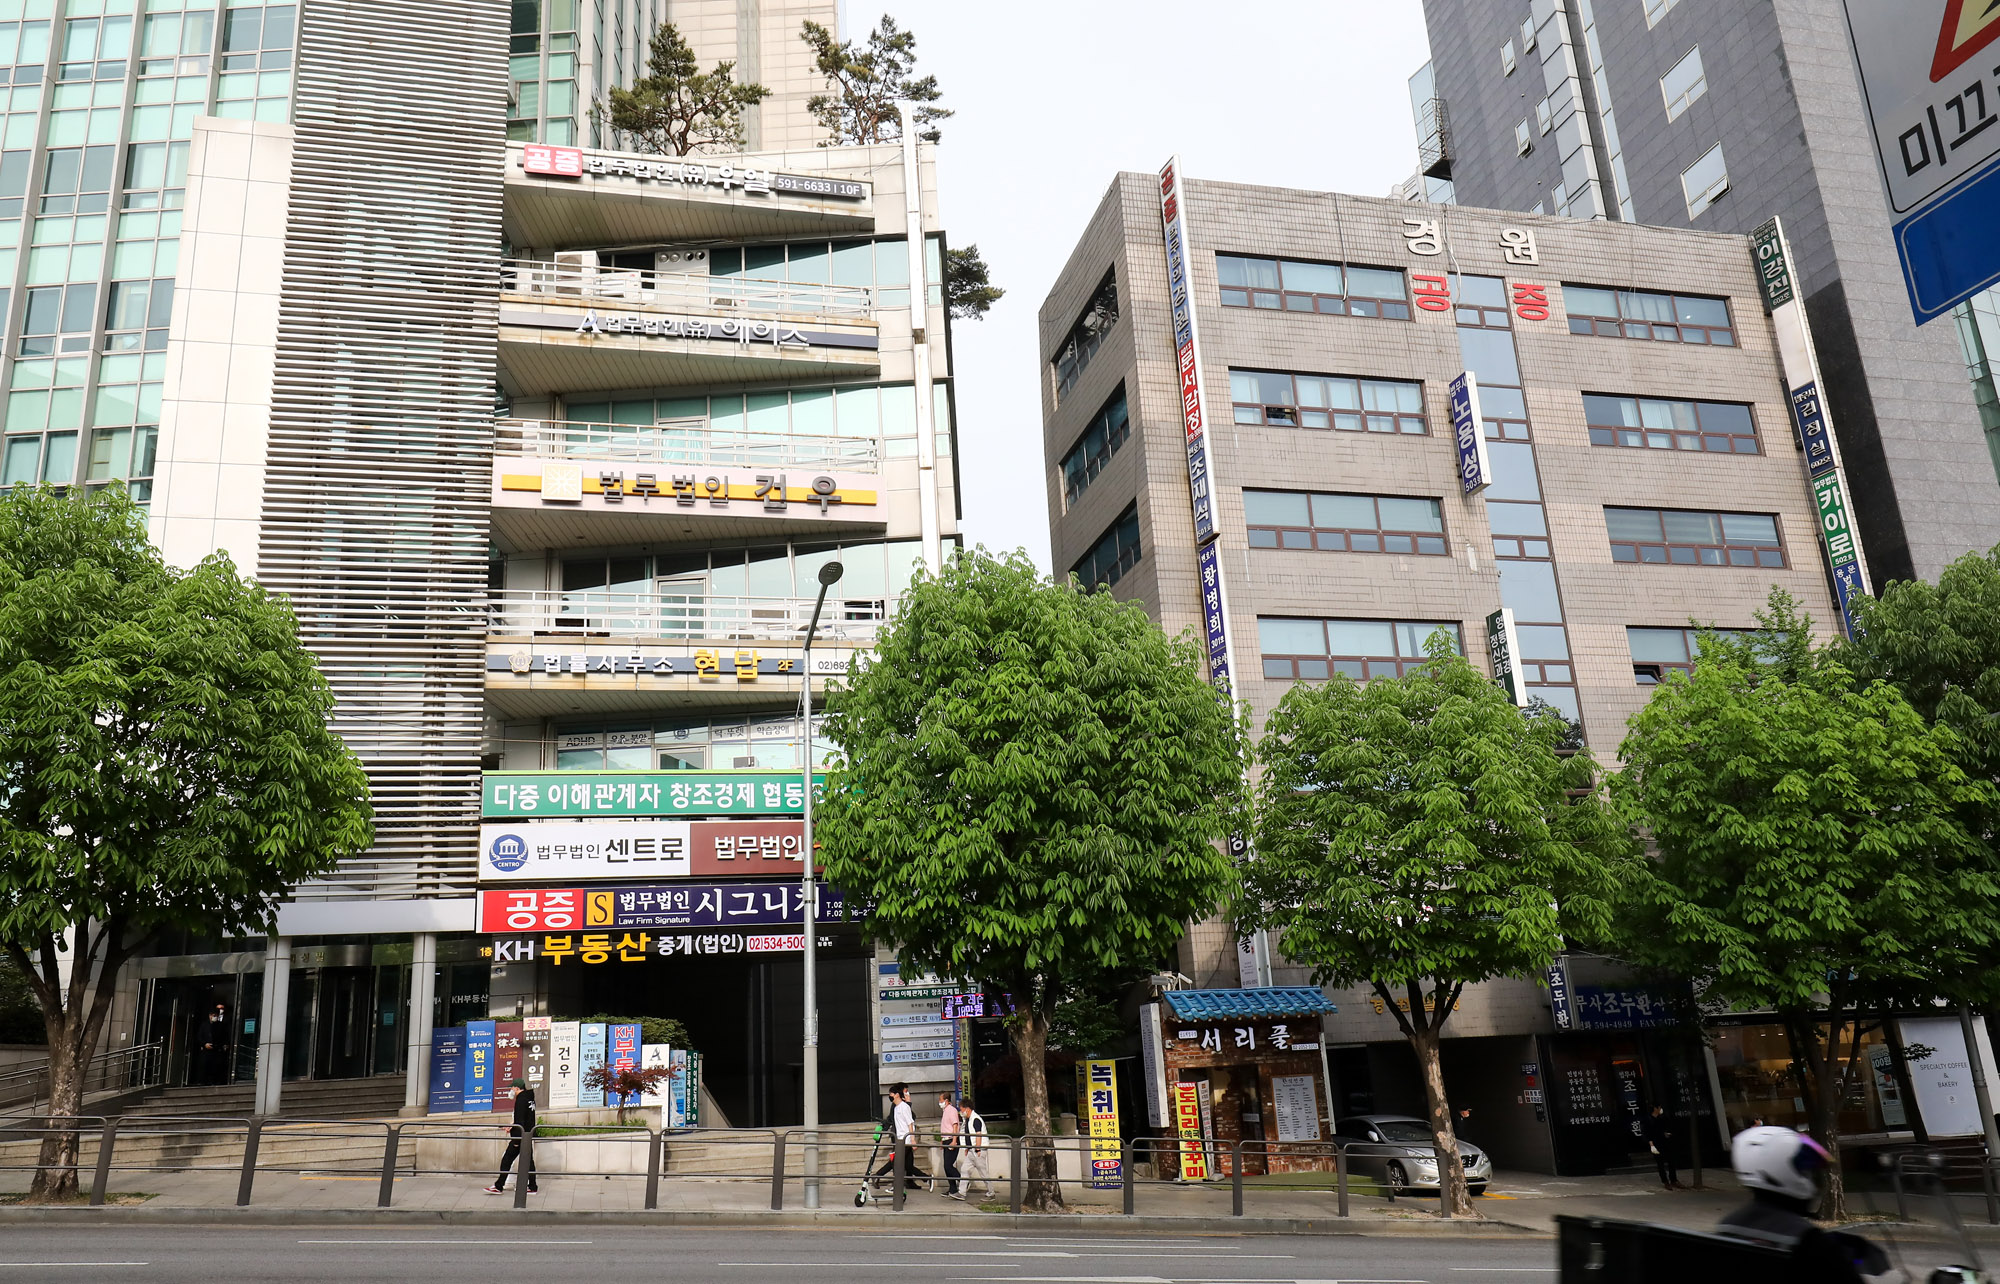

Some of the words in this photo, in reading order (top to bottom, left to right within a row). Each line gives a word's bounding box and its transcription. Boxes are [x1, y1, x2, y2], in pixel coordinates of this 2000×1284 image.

[1899, 66, 2000, 177] 미끄
[528, 148, 579, 173] 공증
[589, 158, 709, 185] 법무법인(유)
[713, 165, 770, 194] 우일
[777, 178, 831, 193] 591-6633
[840, 184, 861, 195] 10F
[1161, 165, 1177, 224] 공증
[1168, 223, 1182, 284] 법무법인
[1759, 243, 1790, 298] 이강진
[1173, 282, 1189, 332] 경원
[605, 316, 711, 339] 법무법인(유)
[720, 318, 810, 347] 에이스
[1181, 350, 1200, 430] 문서감정
[1450, 376, 1468, 397] 법무사
[1454, 399, 1478, 478] 노용성
[1800, 401, 1827, 456] 김정실
[599, 471, 730, 504] 법무법인
[755, 474, 841, 512] 건우
[1191, 456, 1209, 521] 조재석
[1465, 475, 1482, 492] 503호
[1813, 473, 1837, 490] 법무법인
[1818, 486, 1854, 558] 카이로
[1201, 548, 1215, 563] 변호사
[1204, 564, 1222, 633] 황병희
[543, 649, 674, 675] 법률사무소
[694, 649, 763, 680] 현답
[777, 660, 793, 671] 2F
[566, 736, 596, 747] ADHD
[757, 725, 790, 736] 학습장애
[494, 784, 540, 811] 다중
[548, 783, 662, 811] 이해관계자
[670, 782, 756, 809] 창조경제
[537, 843, 600, 861] 법무법인
[605, 837, 685, 864] 센트로
[714, 835, 805, 861] 법무법인
[506, 892, 575, 929] 공증
[590, 894, 608, 924] S
[619, 890, 690, 912] 법무법인
[618, 917, 635, 925] Law
[636, 917, 652, 925] Firm
[654, 915, 690, 925] Signature
[480, 947, 493, 957] 1층
[494, 940, 534, 961] KH
[541, 932, 651, 966] 부동산
[658, 933, 744, 954] 중개(법인)
[748, 935, 805, 951] 02)534-500
[452, 993, 489, 1004] KH부동산
[1550, 972, 1570, 1029] 조두환
[527, 1019, 548, 1029] 공증
[614, 1026, 635, 1039] KH
[909, 1015, 928, 1023] 센트로
[1201, 1025, 1290, 1051] 서리풀
[473, 1050, 486, 1078] 현답
[528, 1045, 545, 1081] 우일
[558, 1046, 571, 1079] 건우
[911, 1052, 930, 1060] 센트로
[1920, 1062, 1948, 1071] SPECIALTY
[1948, 1061, 1968, 1069] COFFEE
[1091, 1064, 1114, 1113] 녹취
[1180, 1092, 1199, 1129] 도다리
[1624, 1080, 1643, 1137] 조두환
